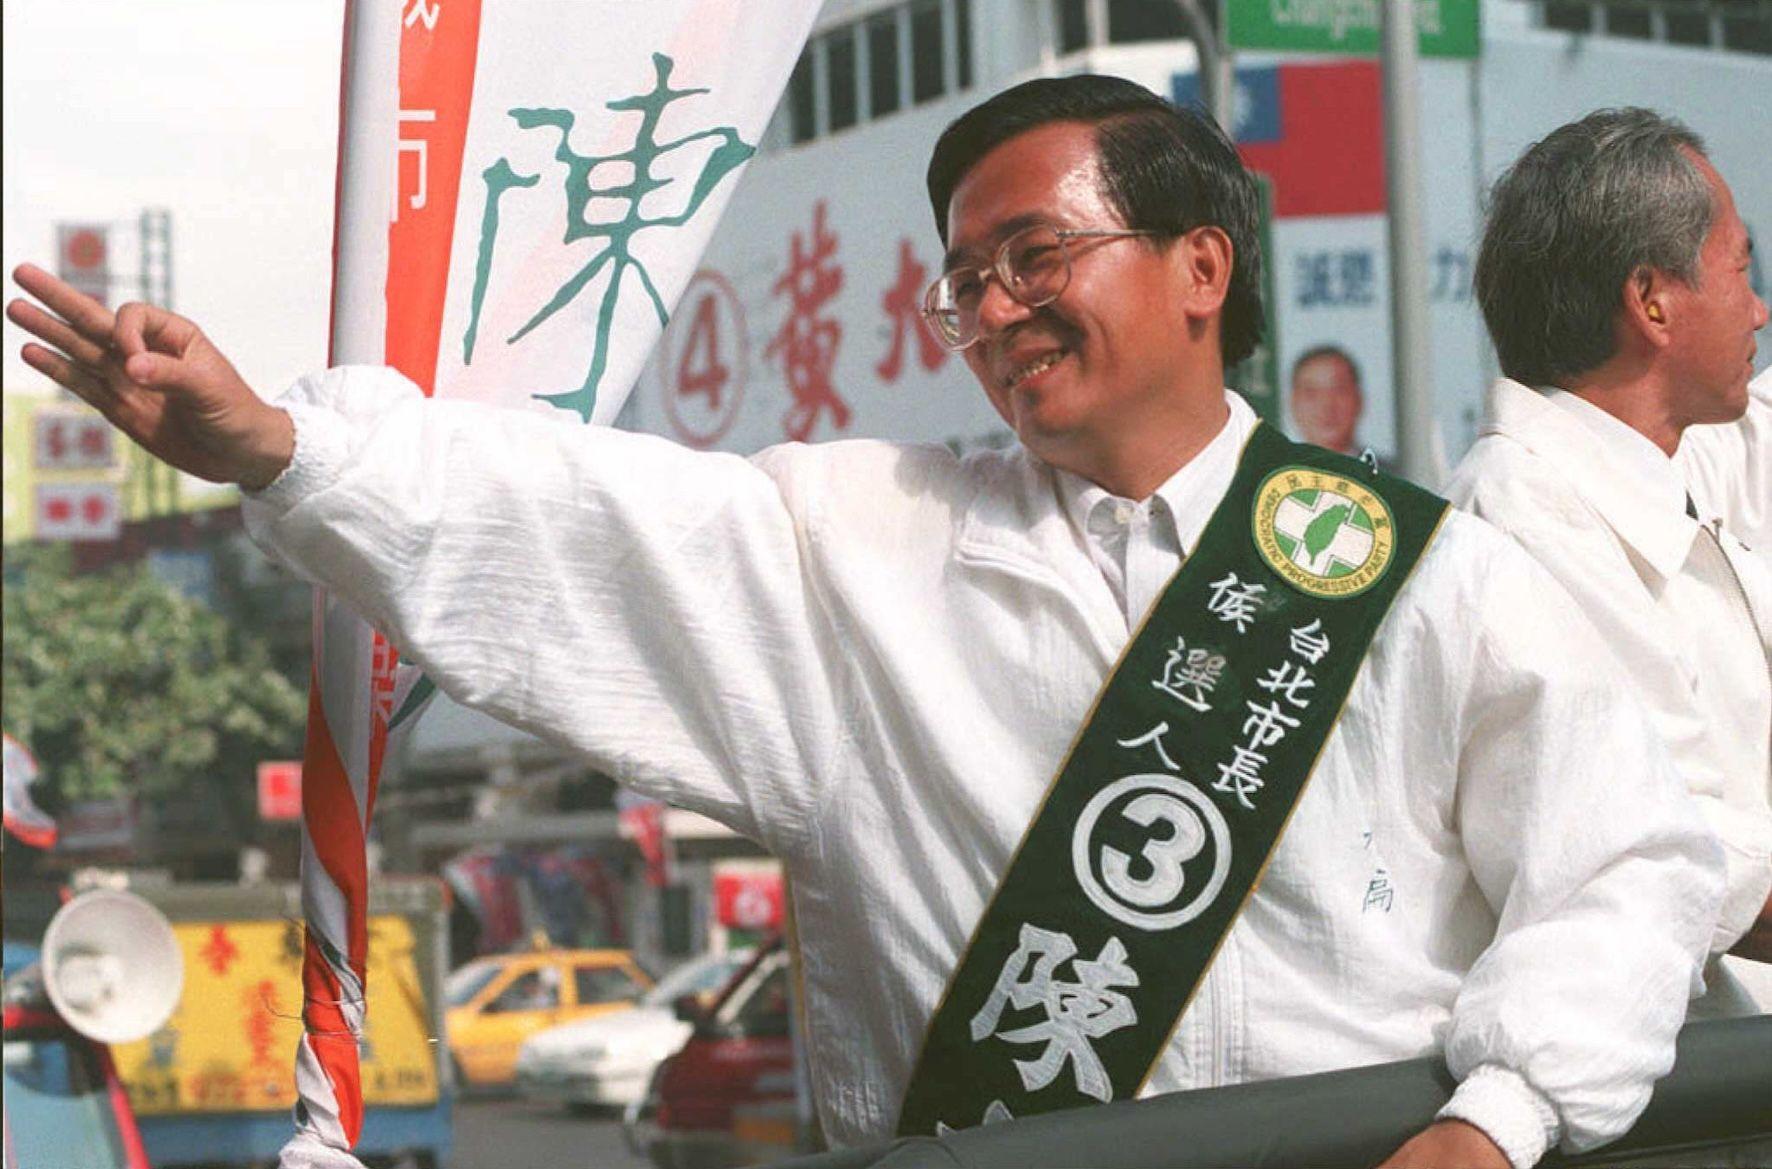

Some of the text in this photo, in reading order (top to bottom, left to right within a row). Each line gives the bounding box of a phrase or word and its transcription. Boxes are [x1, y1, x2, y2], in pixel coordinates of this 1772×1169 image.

[463, 52, 757, 425] 陳
[1116, 572, 1266, 771] 候選人
[1211, 618, 1331, 810] 台北市長
[937, 922, 1140, 1138] 陳
